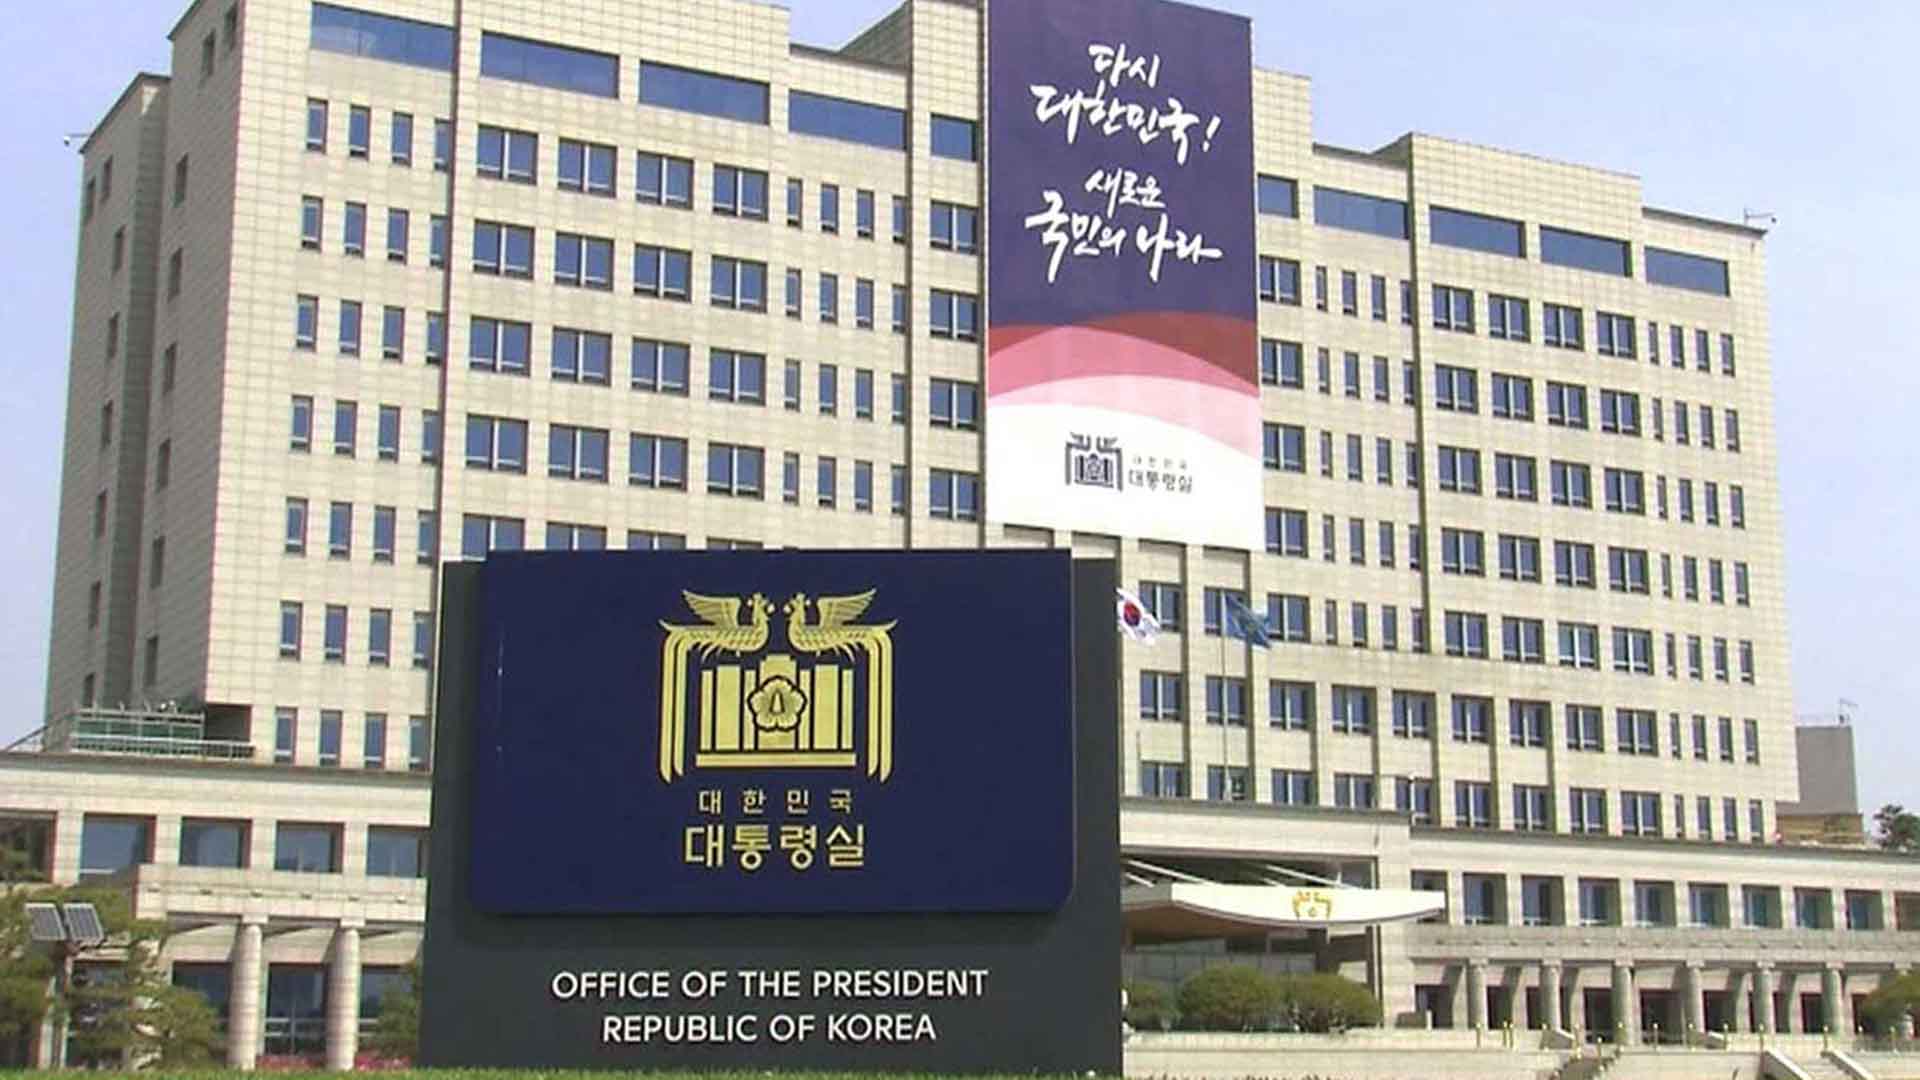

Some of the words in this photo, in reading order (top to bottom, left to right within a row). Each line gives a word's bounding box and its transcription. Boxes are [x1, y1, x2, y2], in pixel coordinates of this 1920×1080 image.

[1088, 43, 1160, 89] 다시
[1030, 79, 1222, 166] 대한민국!
[1085, 167, 1167, 219] 새로운
[1025, 191, 1127, 283] 국민의
[1136, 213, 1223, 283] 나라
[699, 789, 853, 815] 대한민국
[684, 824, 865, 870] 대통령실
[552, 971, 670, 998] OFFICE
[681, 971, 728, 998] OF
[738, 970, 801, 998] THE
[813, 969, 989, 998] PRESIDENT
[603, 1015, 757, 1043] REPUBLIC
[769, 1015, 815, 1042] OF
[828, 1014, 936, 1041] KOREA
